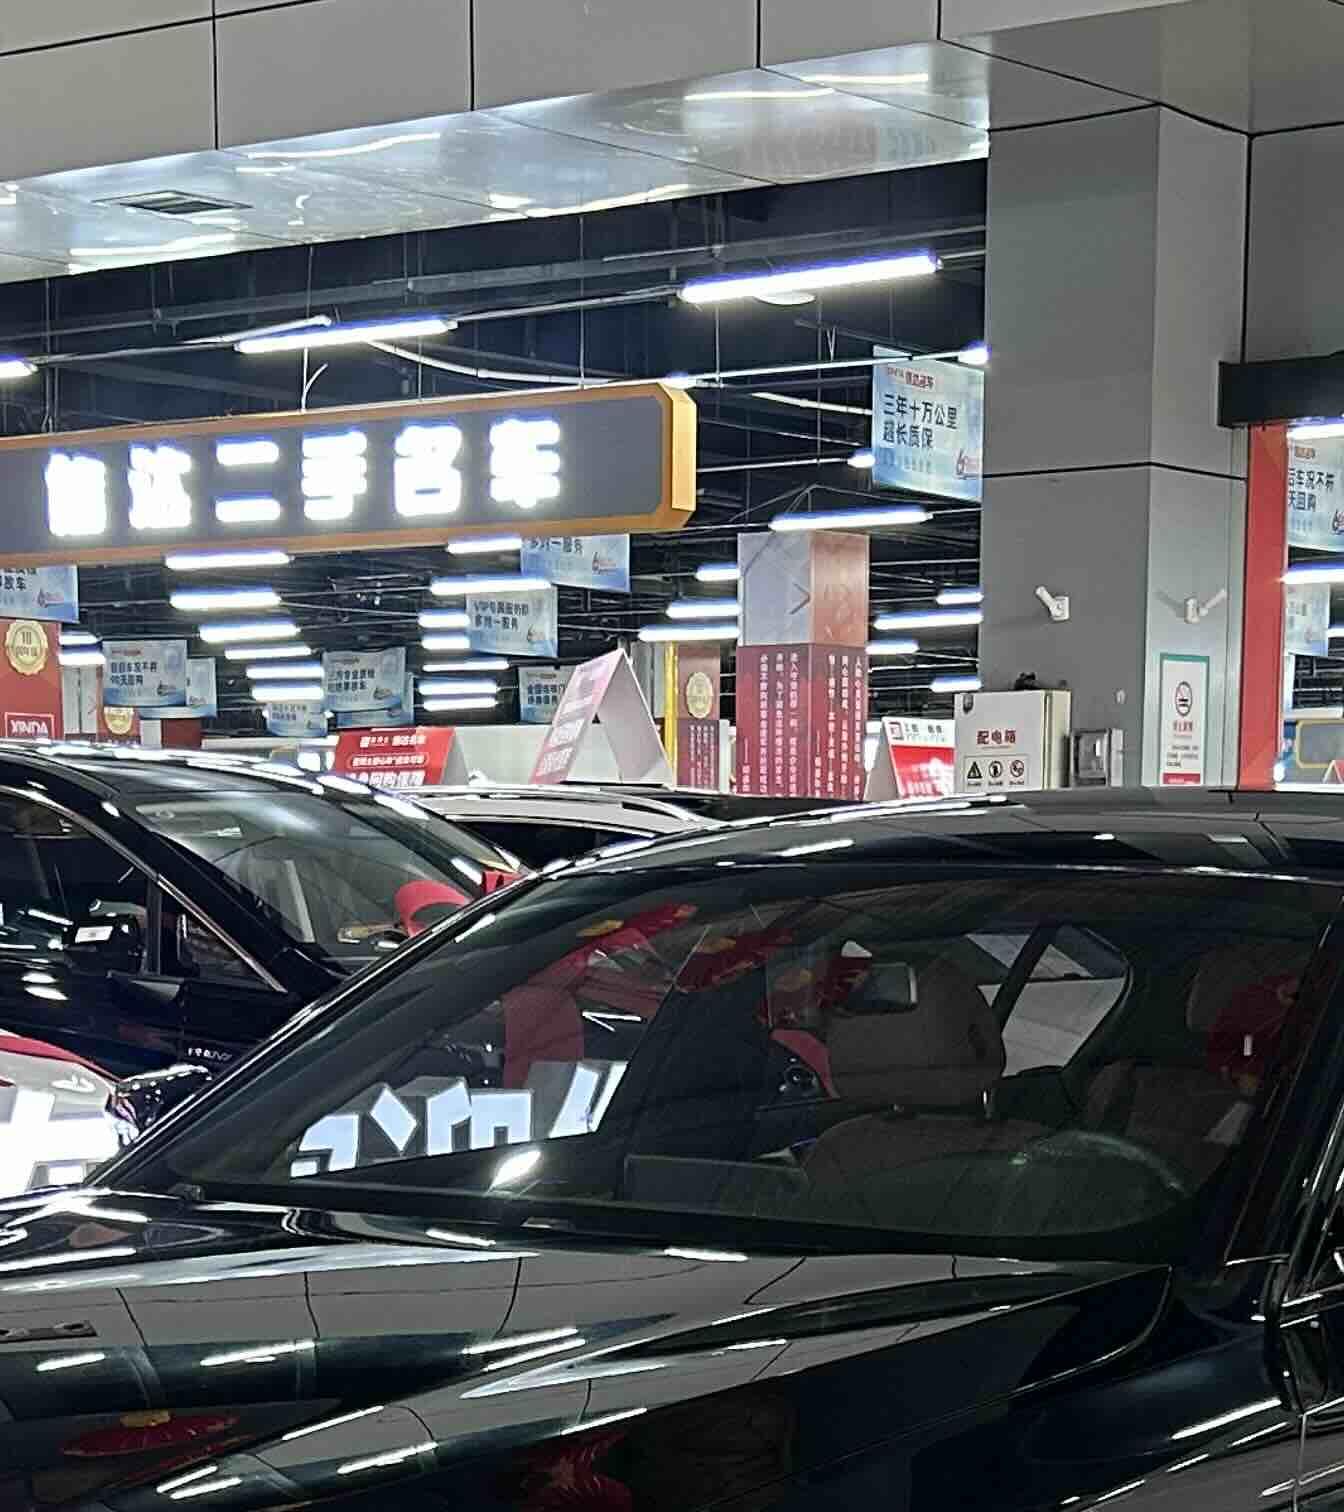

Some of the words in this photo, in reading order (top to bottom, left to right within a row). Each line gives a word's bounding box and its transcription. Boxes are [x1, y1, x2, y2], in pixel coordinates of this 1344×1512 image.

[883, 392, 959, 430] 三年十万公里
[9, 719, 50, 735] XINDA
[976, 729, 1017, 746] 配电箱
